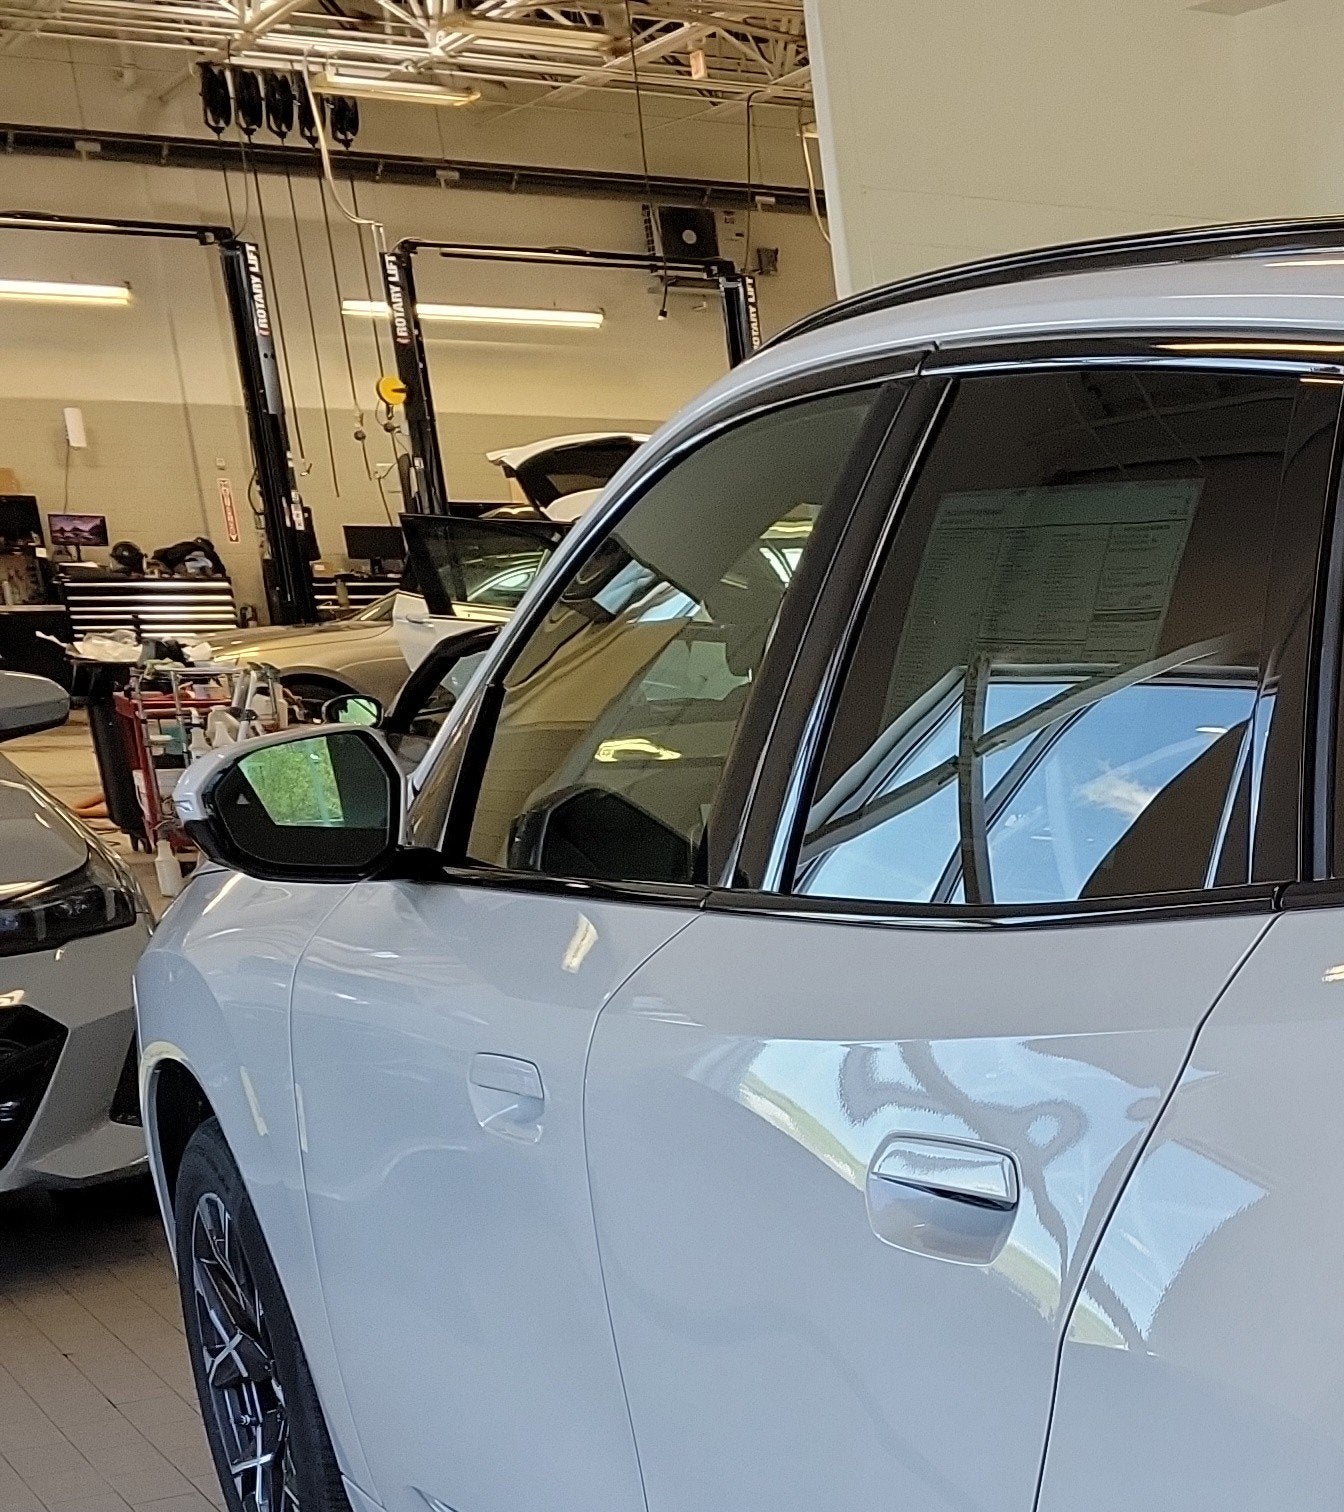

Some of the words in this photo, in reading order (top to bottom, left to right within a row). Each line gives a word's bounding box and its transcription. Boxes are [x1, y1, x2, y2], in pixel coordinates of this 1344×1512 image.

[245, 243, 260, 273] LIFT
[384, 253, 400, 282] LIFT
[249, 275, 269, 329] ROTARY
[388, 284, 409, 337] ROTARY
